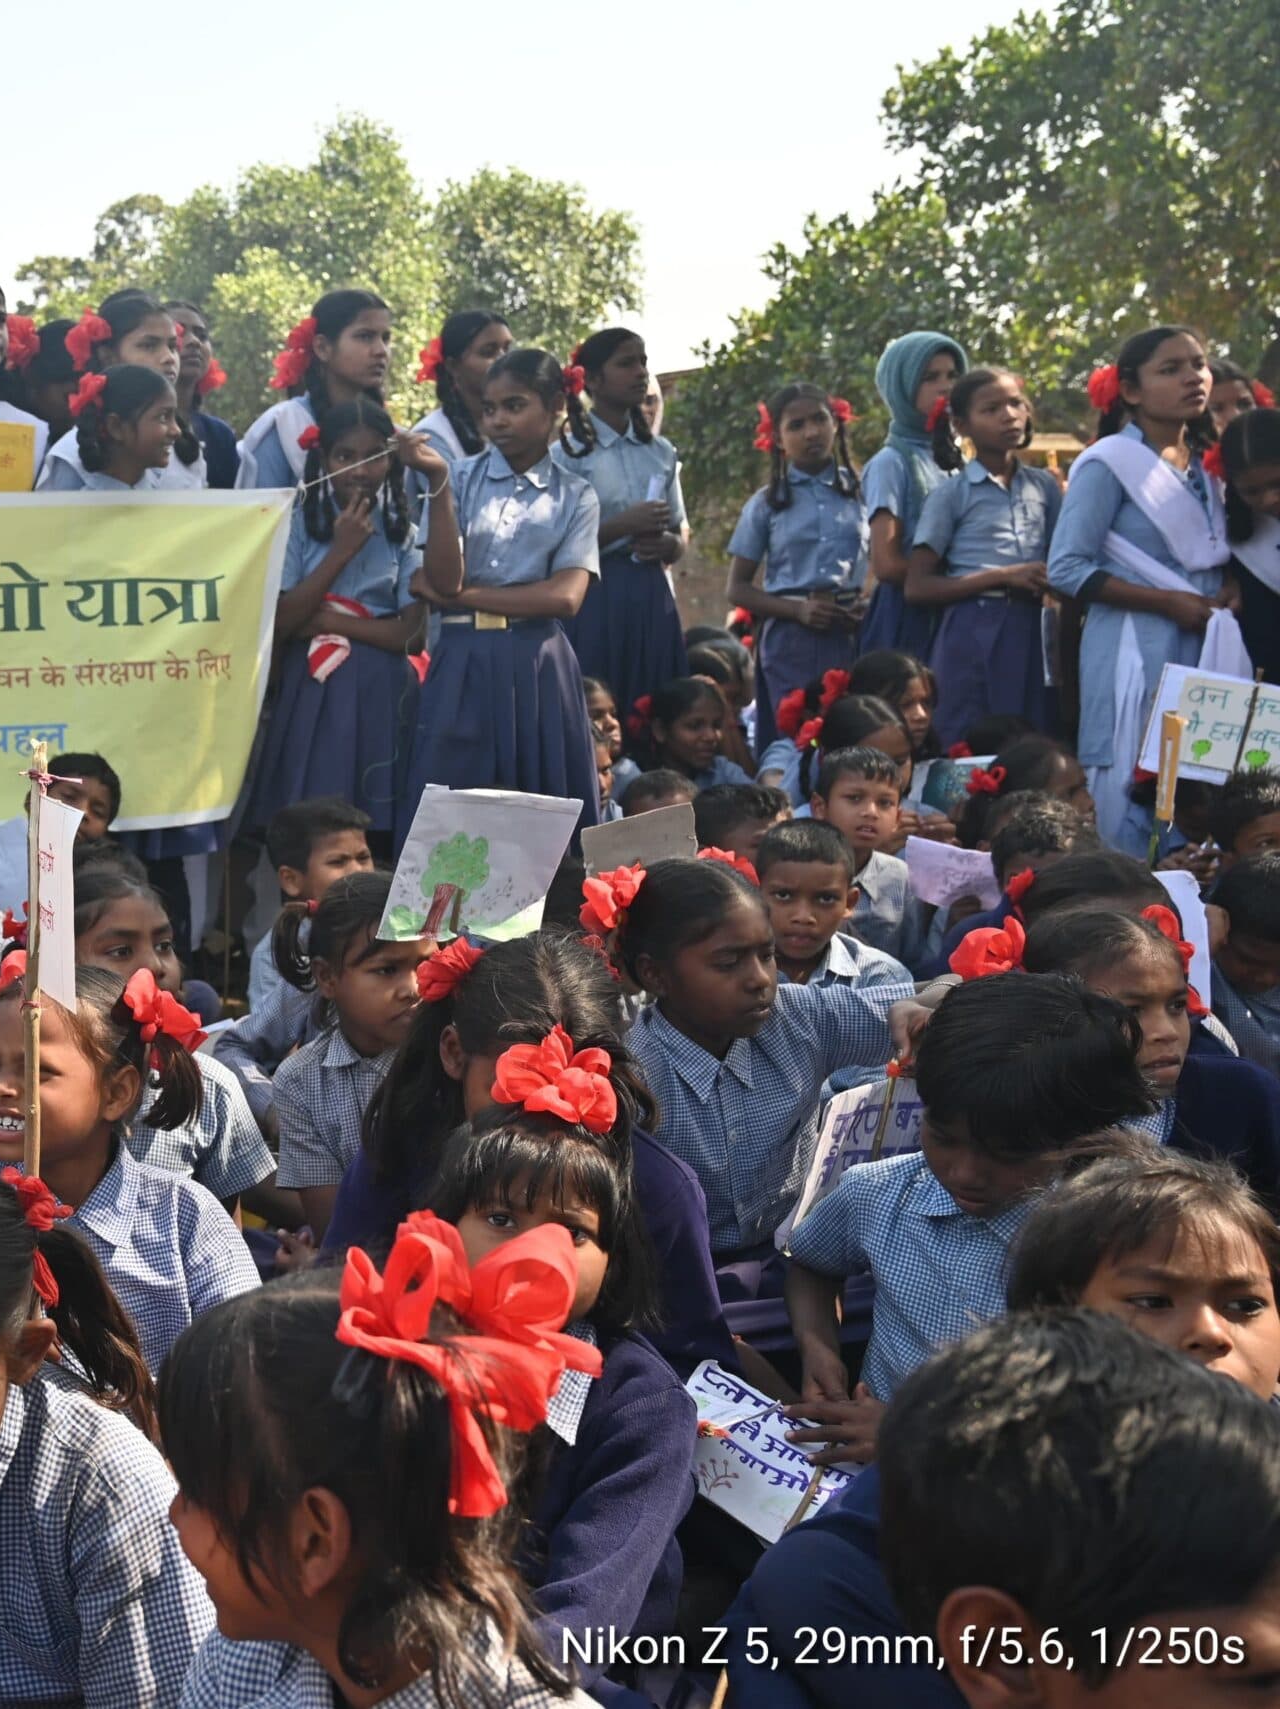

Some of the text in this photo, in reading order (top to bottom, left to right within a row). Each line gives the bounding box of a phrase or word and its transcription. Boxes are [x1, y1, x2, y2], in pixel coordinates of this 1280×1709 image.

[64, 575, 225, 627] यात्रा
[39, 656, 66, 687] के
[74, 659, 156, 687] संरक्षण
[163, 651, 191, 681] के
[194, 648, 232, 680] लिए
